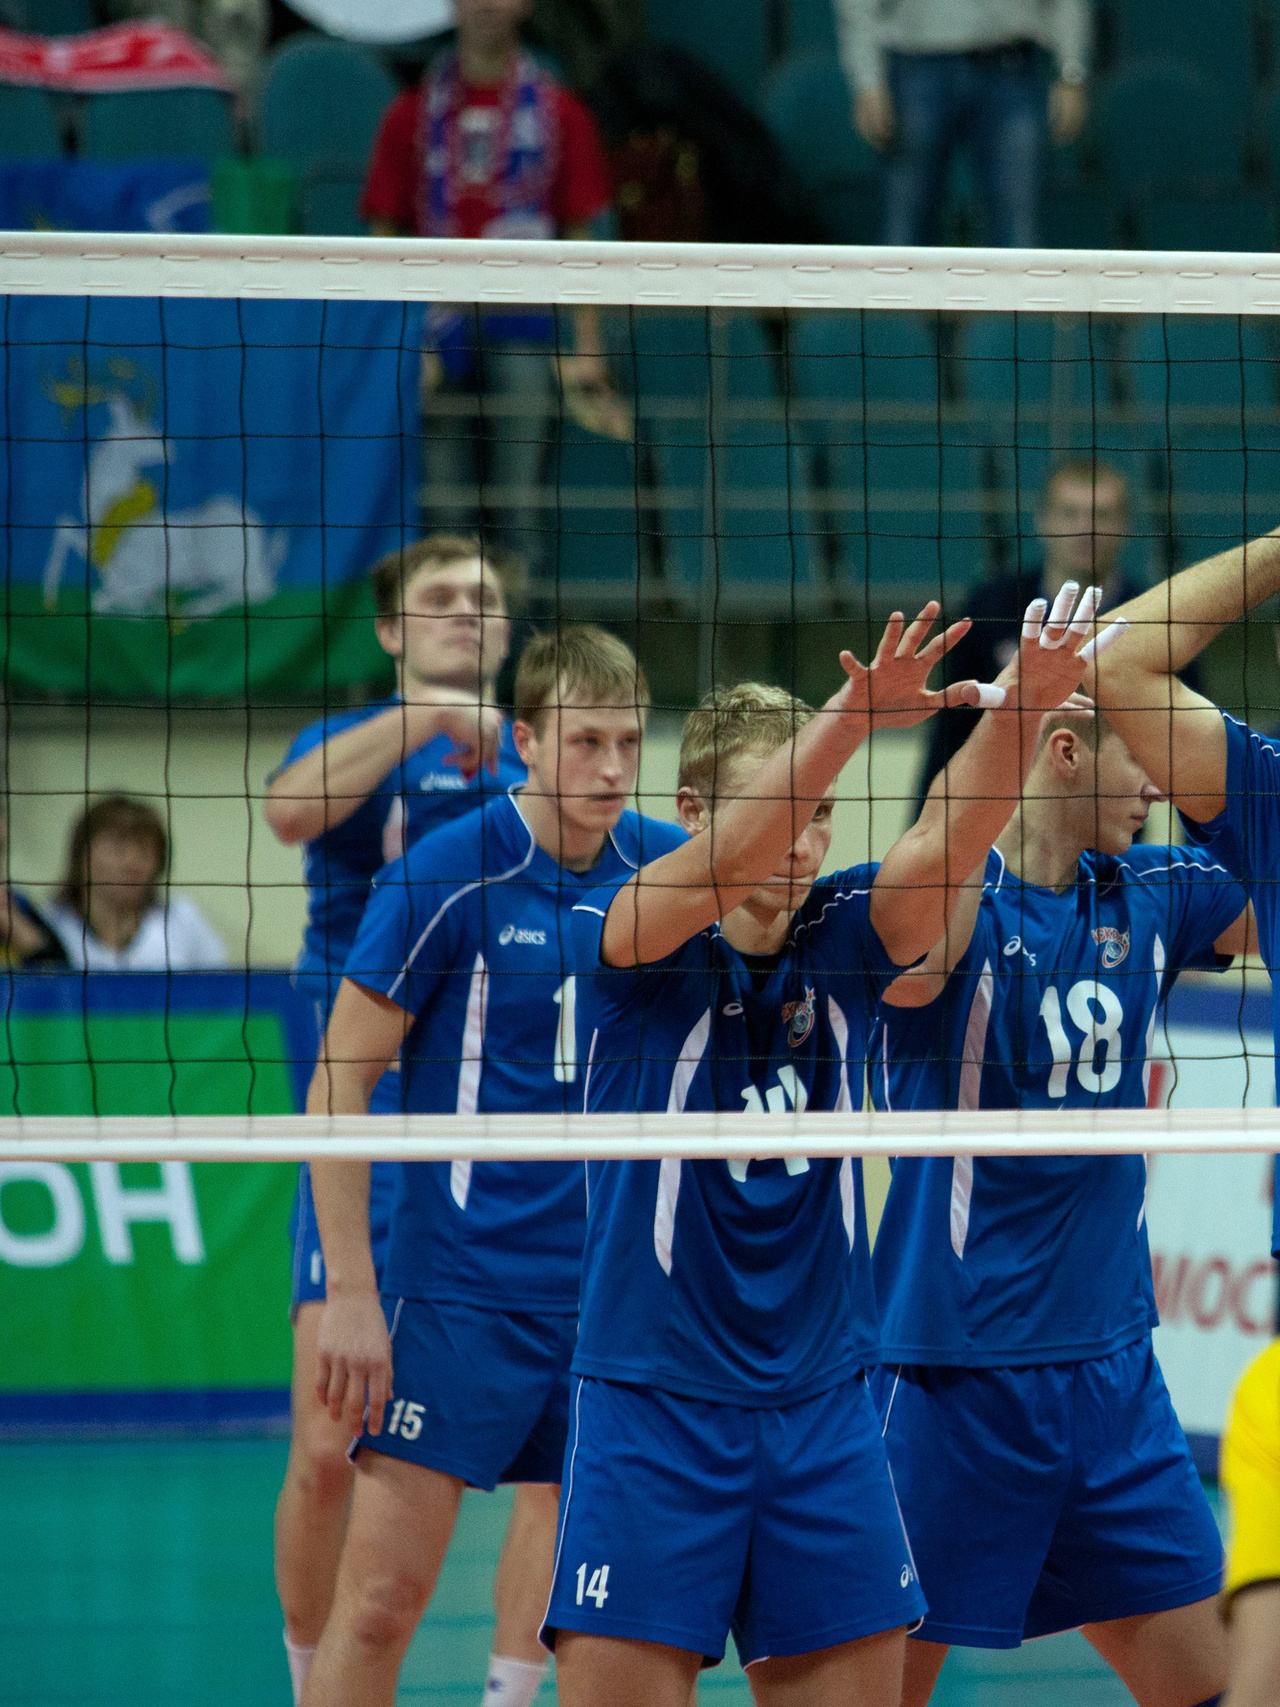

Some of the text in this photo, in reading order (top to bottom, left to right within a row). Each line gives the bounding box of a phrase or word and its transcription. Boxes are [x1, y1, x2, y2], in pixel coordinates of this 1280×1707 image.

[1039, 980, 1123, 1098] 18
[388, 1399, 426, 1440] 15
[575, 1562, 609, 1608] 14
